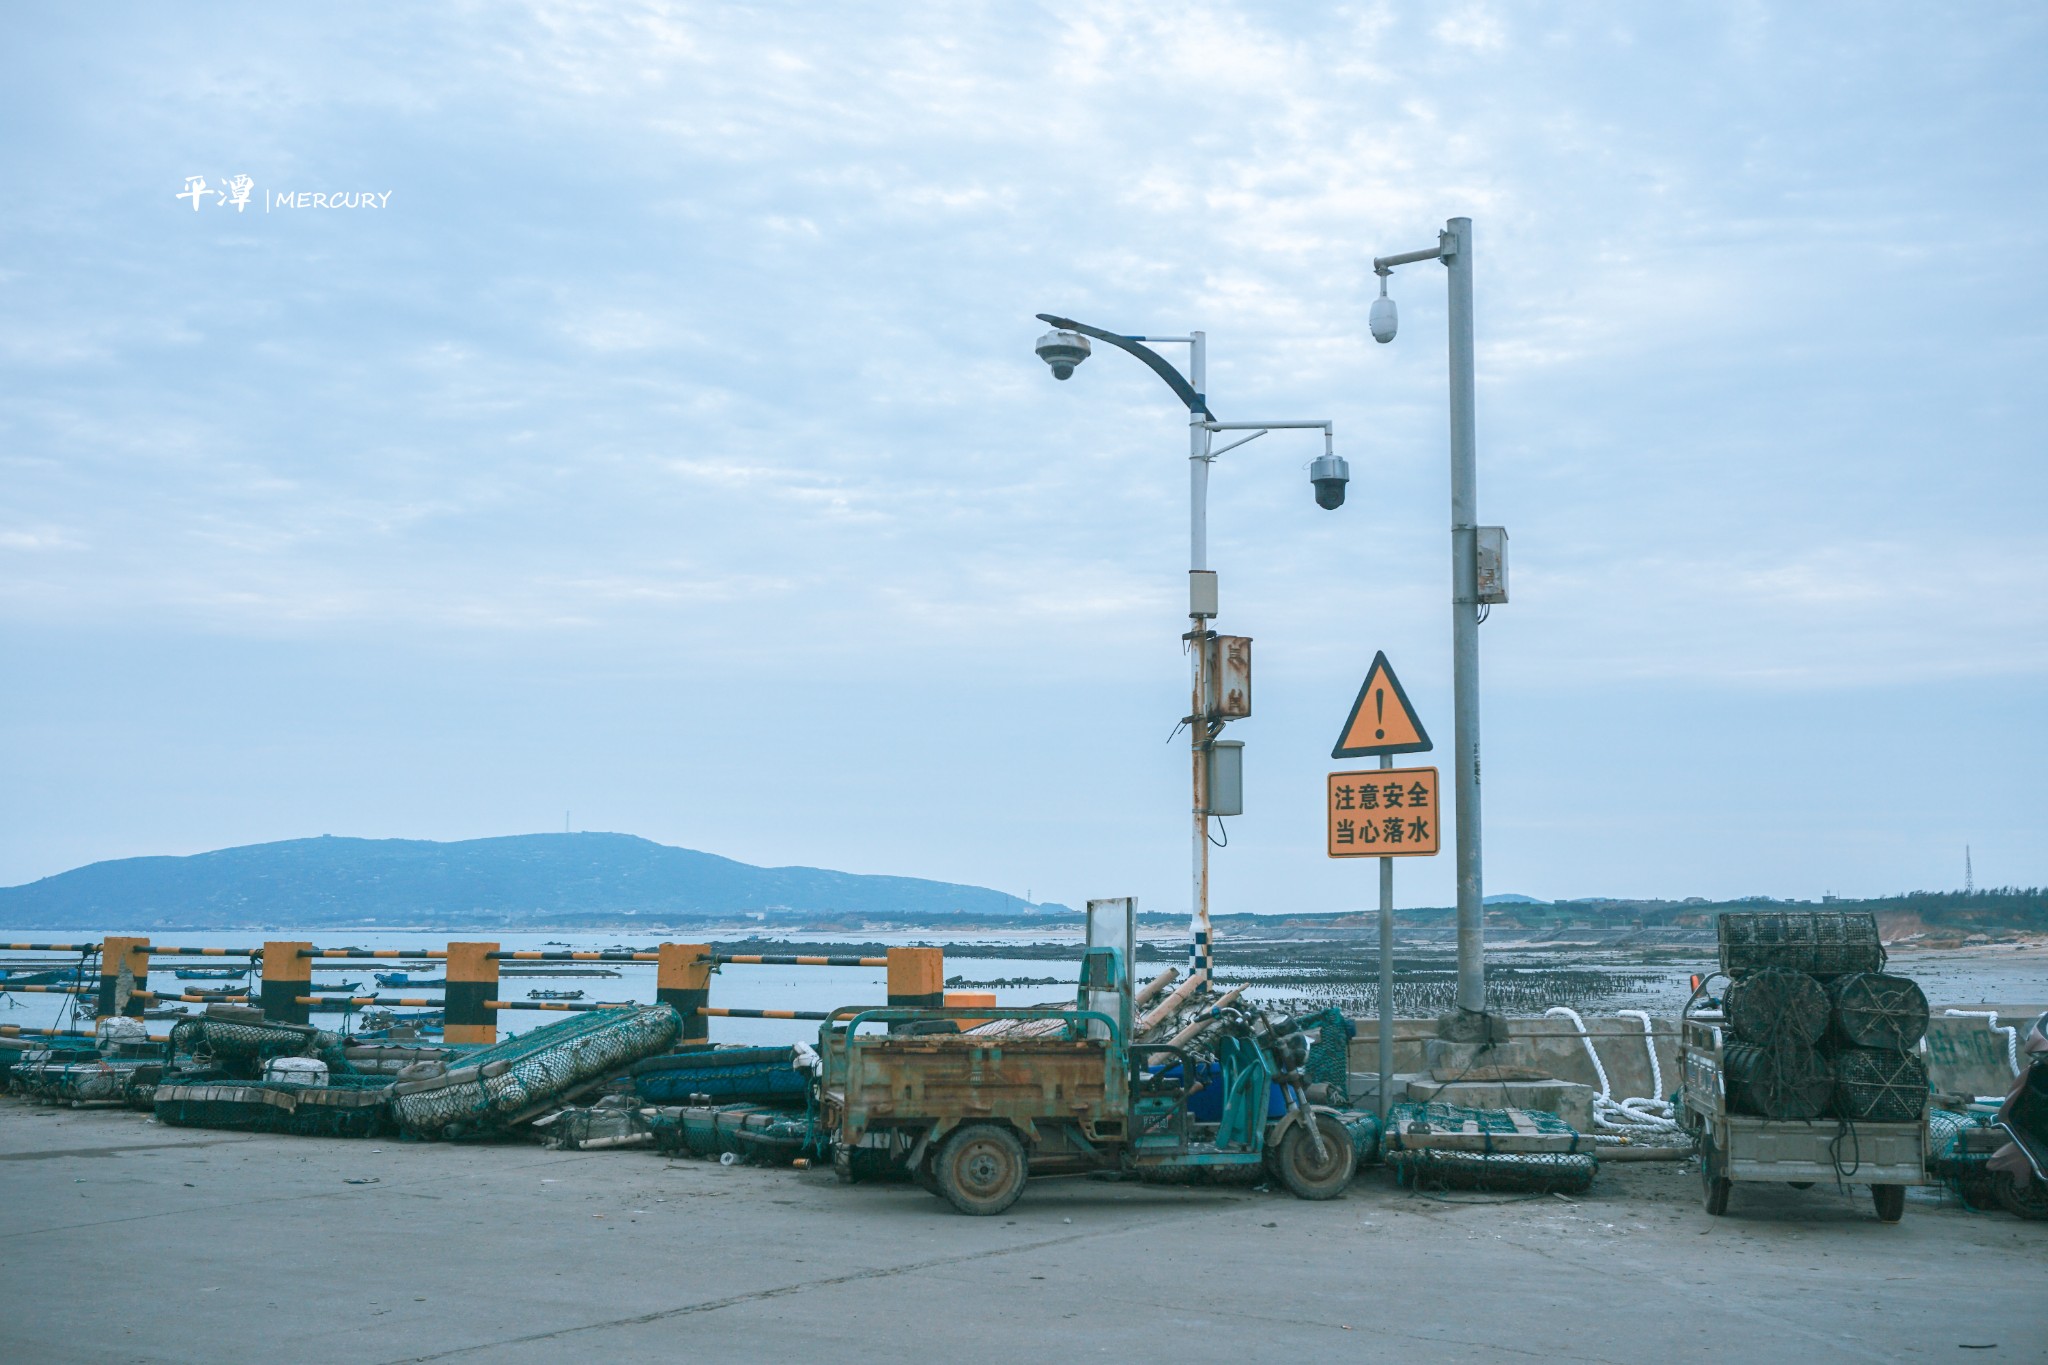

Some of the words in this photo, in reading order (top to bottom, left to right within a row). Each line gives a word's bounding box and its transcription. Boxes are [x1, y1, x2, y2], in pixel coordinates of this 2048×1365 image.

[1334, 781, 1430, 811] 注意安全
[1335, 816, 1431, 845] 当心落水
